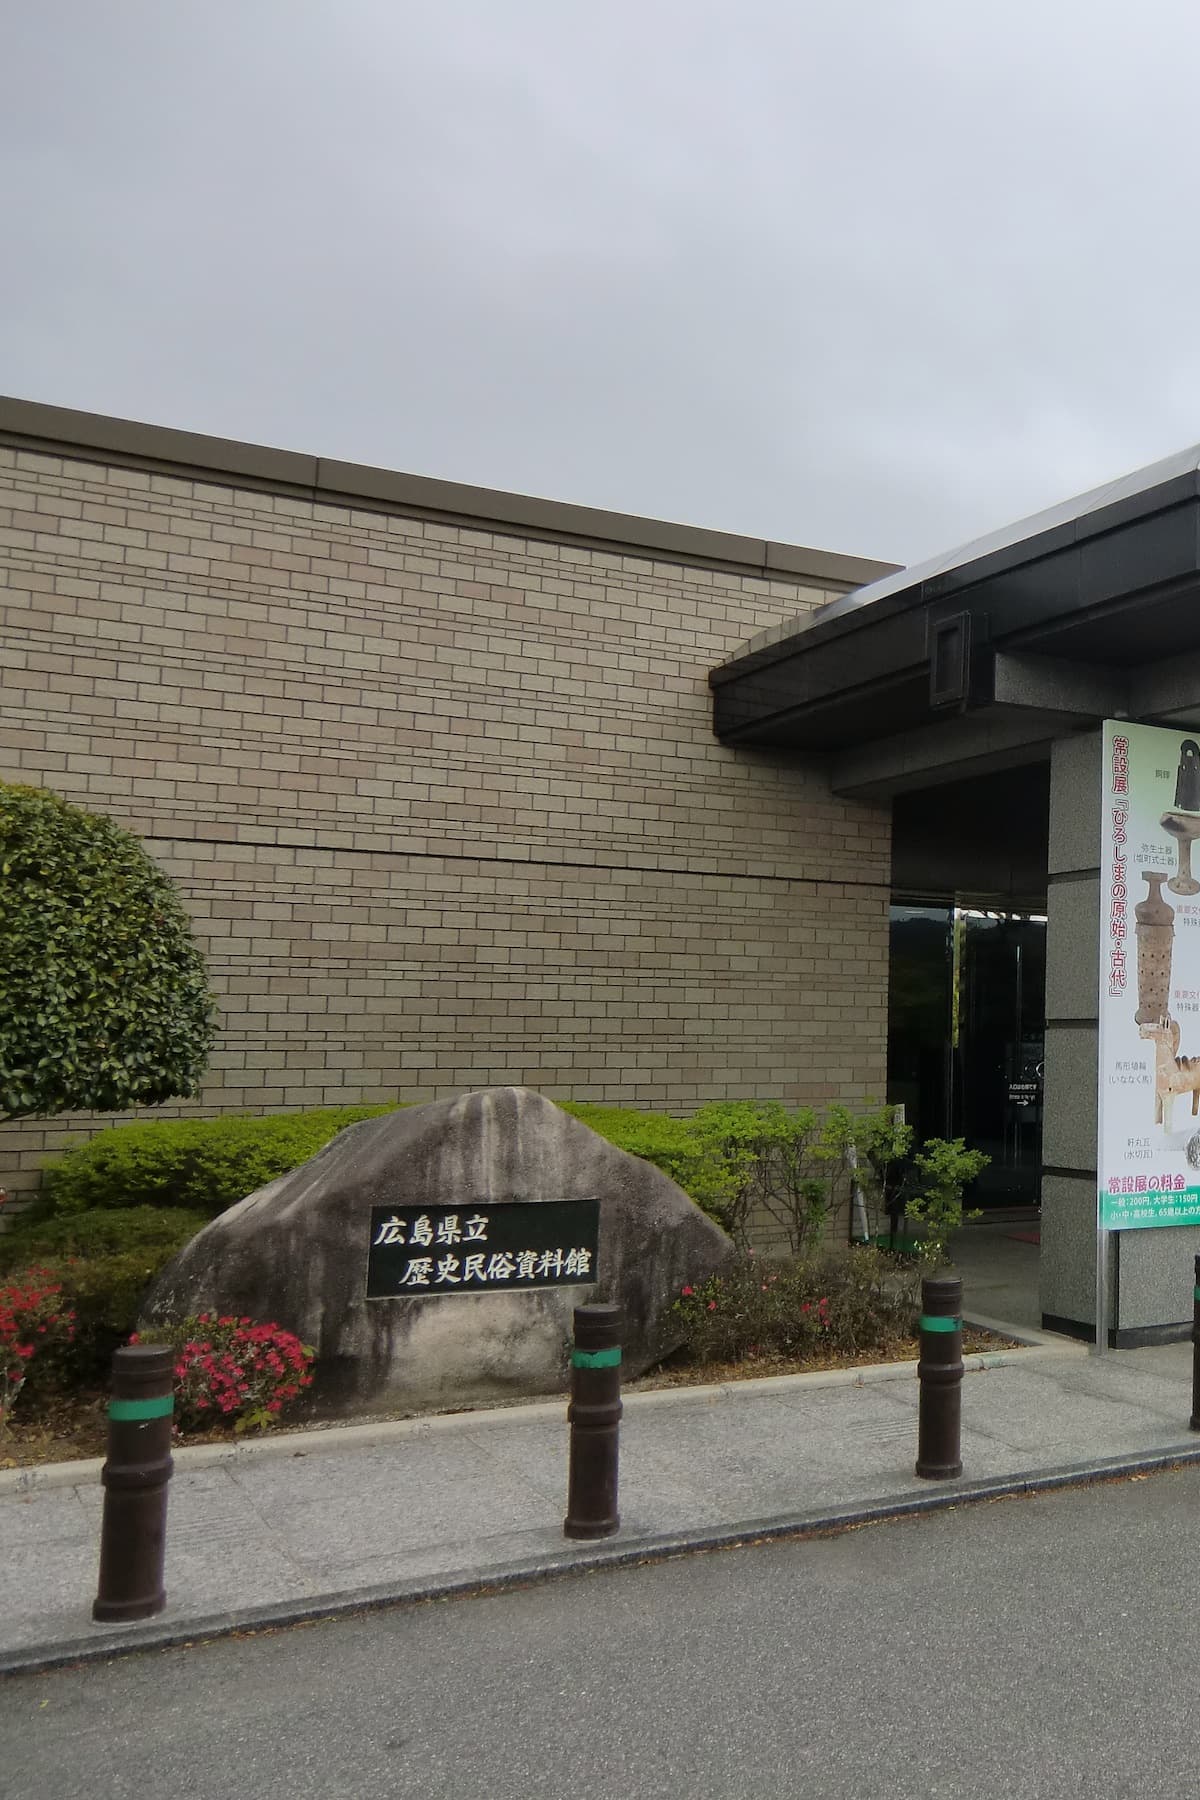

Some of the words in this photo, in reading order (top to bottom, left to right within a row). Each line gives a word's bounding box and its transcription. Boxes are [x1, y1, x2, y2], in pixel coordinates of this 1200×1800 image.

[1108, 1174, 1185, 1194] 常設展の料金
[373, 1214, 489, 1247] 広島県立
[399, 1247, 593, 1286] 歴史民俗資料館
